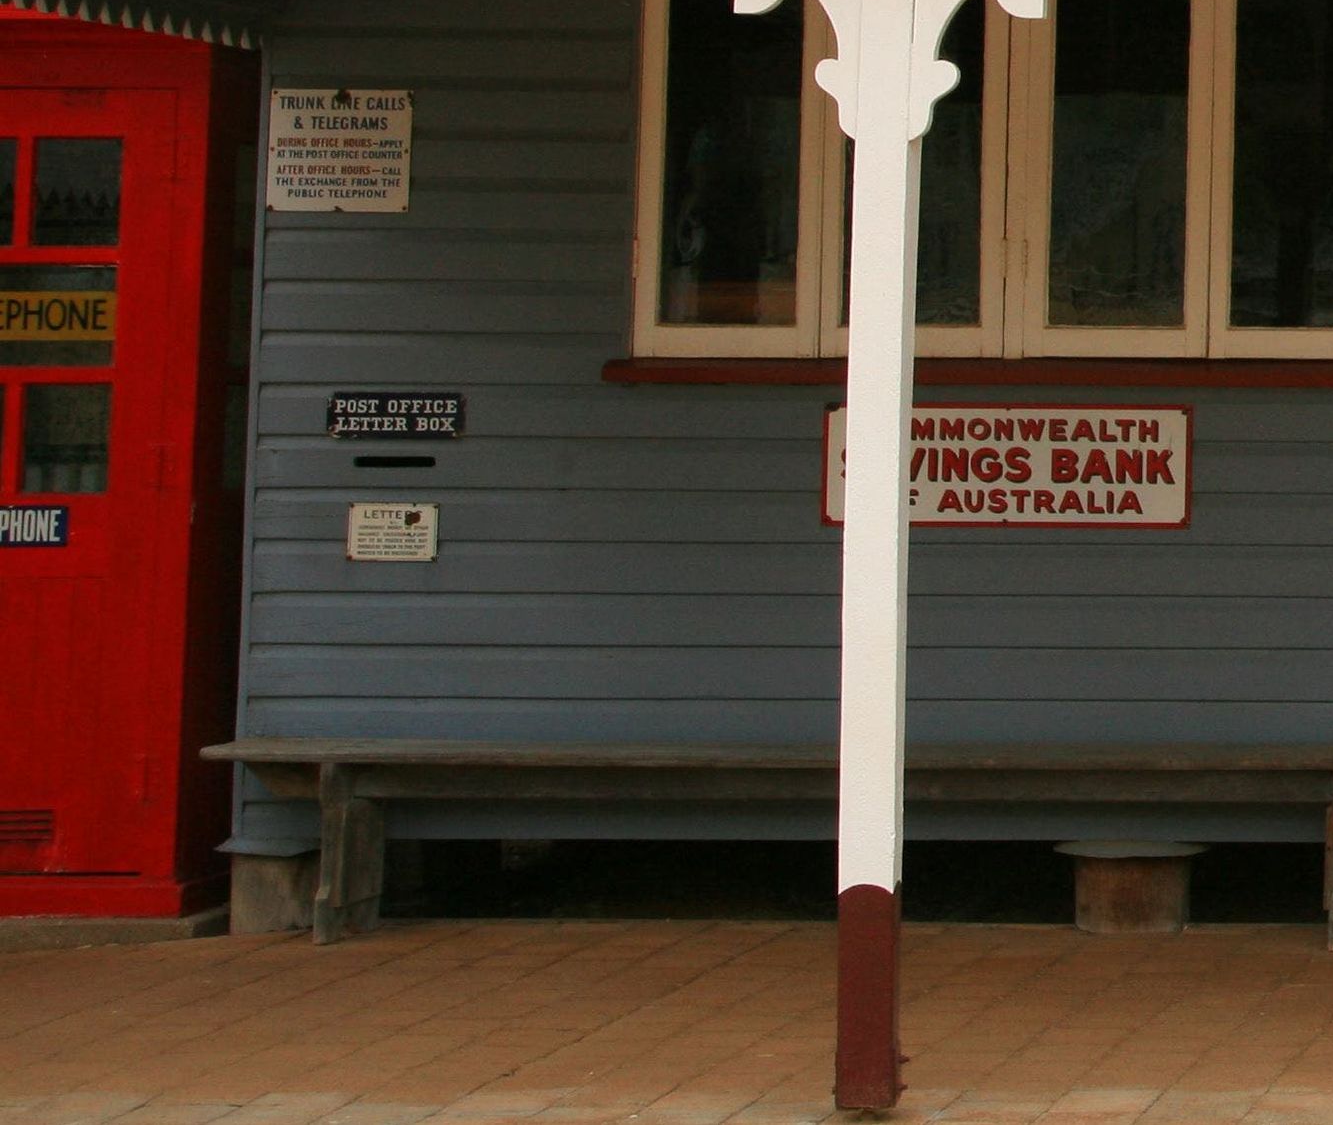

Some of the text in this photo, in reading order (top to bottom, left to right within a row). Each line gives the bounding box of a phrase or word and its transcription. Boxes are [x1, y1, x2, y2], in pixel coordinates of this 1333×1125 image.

[279, 96, 325, 111] TRUNK
[366, 97, 406, 111] CALLS
[293, 116, 389, 131] & TELEGRAMS
[277, 137, 307, 148] DURING
[311, 138, 339, 148] OFFICE
[276, 149, 284, 159] AT
[289, 150, 304, 159] THE
[306, 150, 328, 159] POST
[330, 150, 360, 160] OFFICE
[276, 165, 305, 175] AFTER
[307, 165, 337, 175] OFFICE
[276, 177, 401, 188] THE EXCHANGE FROM THE
[287, 188, 388, 199] PUBLIC TELEPHONE
[0, 298, 107, 331] PHONE
[334, 399, 458, 414] POST OFFICE
[336, 417, 455, 431] LETTER BOX
[911, 417, 1160, 443] MMONWEALTH
[841, 446, 1176, 485] VINGS BANK
[936, 488, 1144, 515] AUSTRALIA
[364, 509, 422, 520] LETTE
